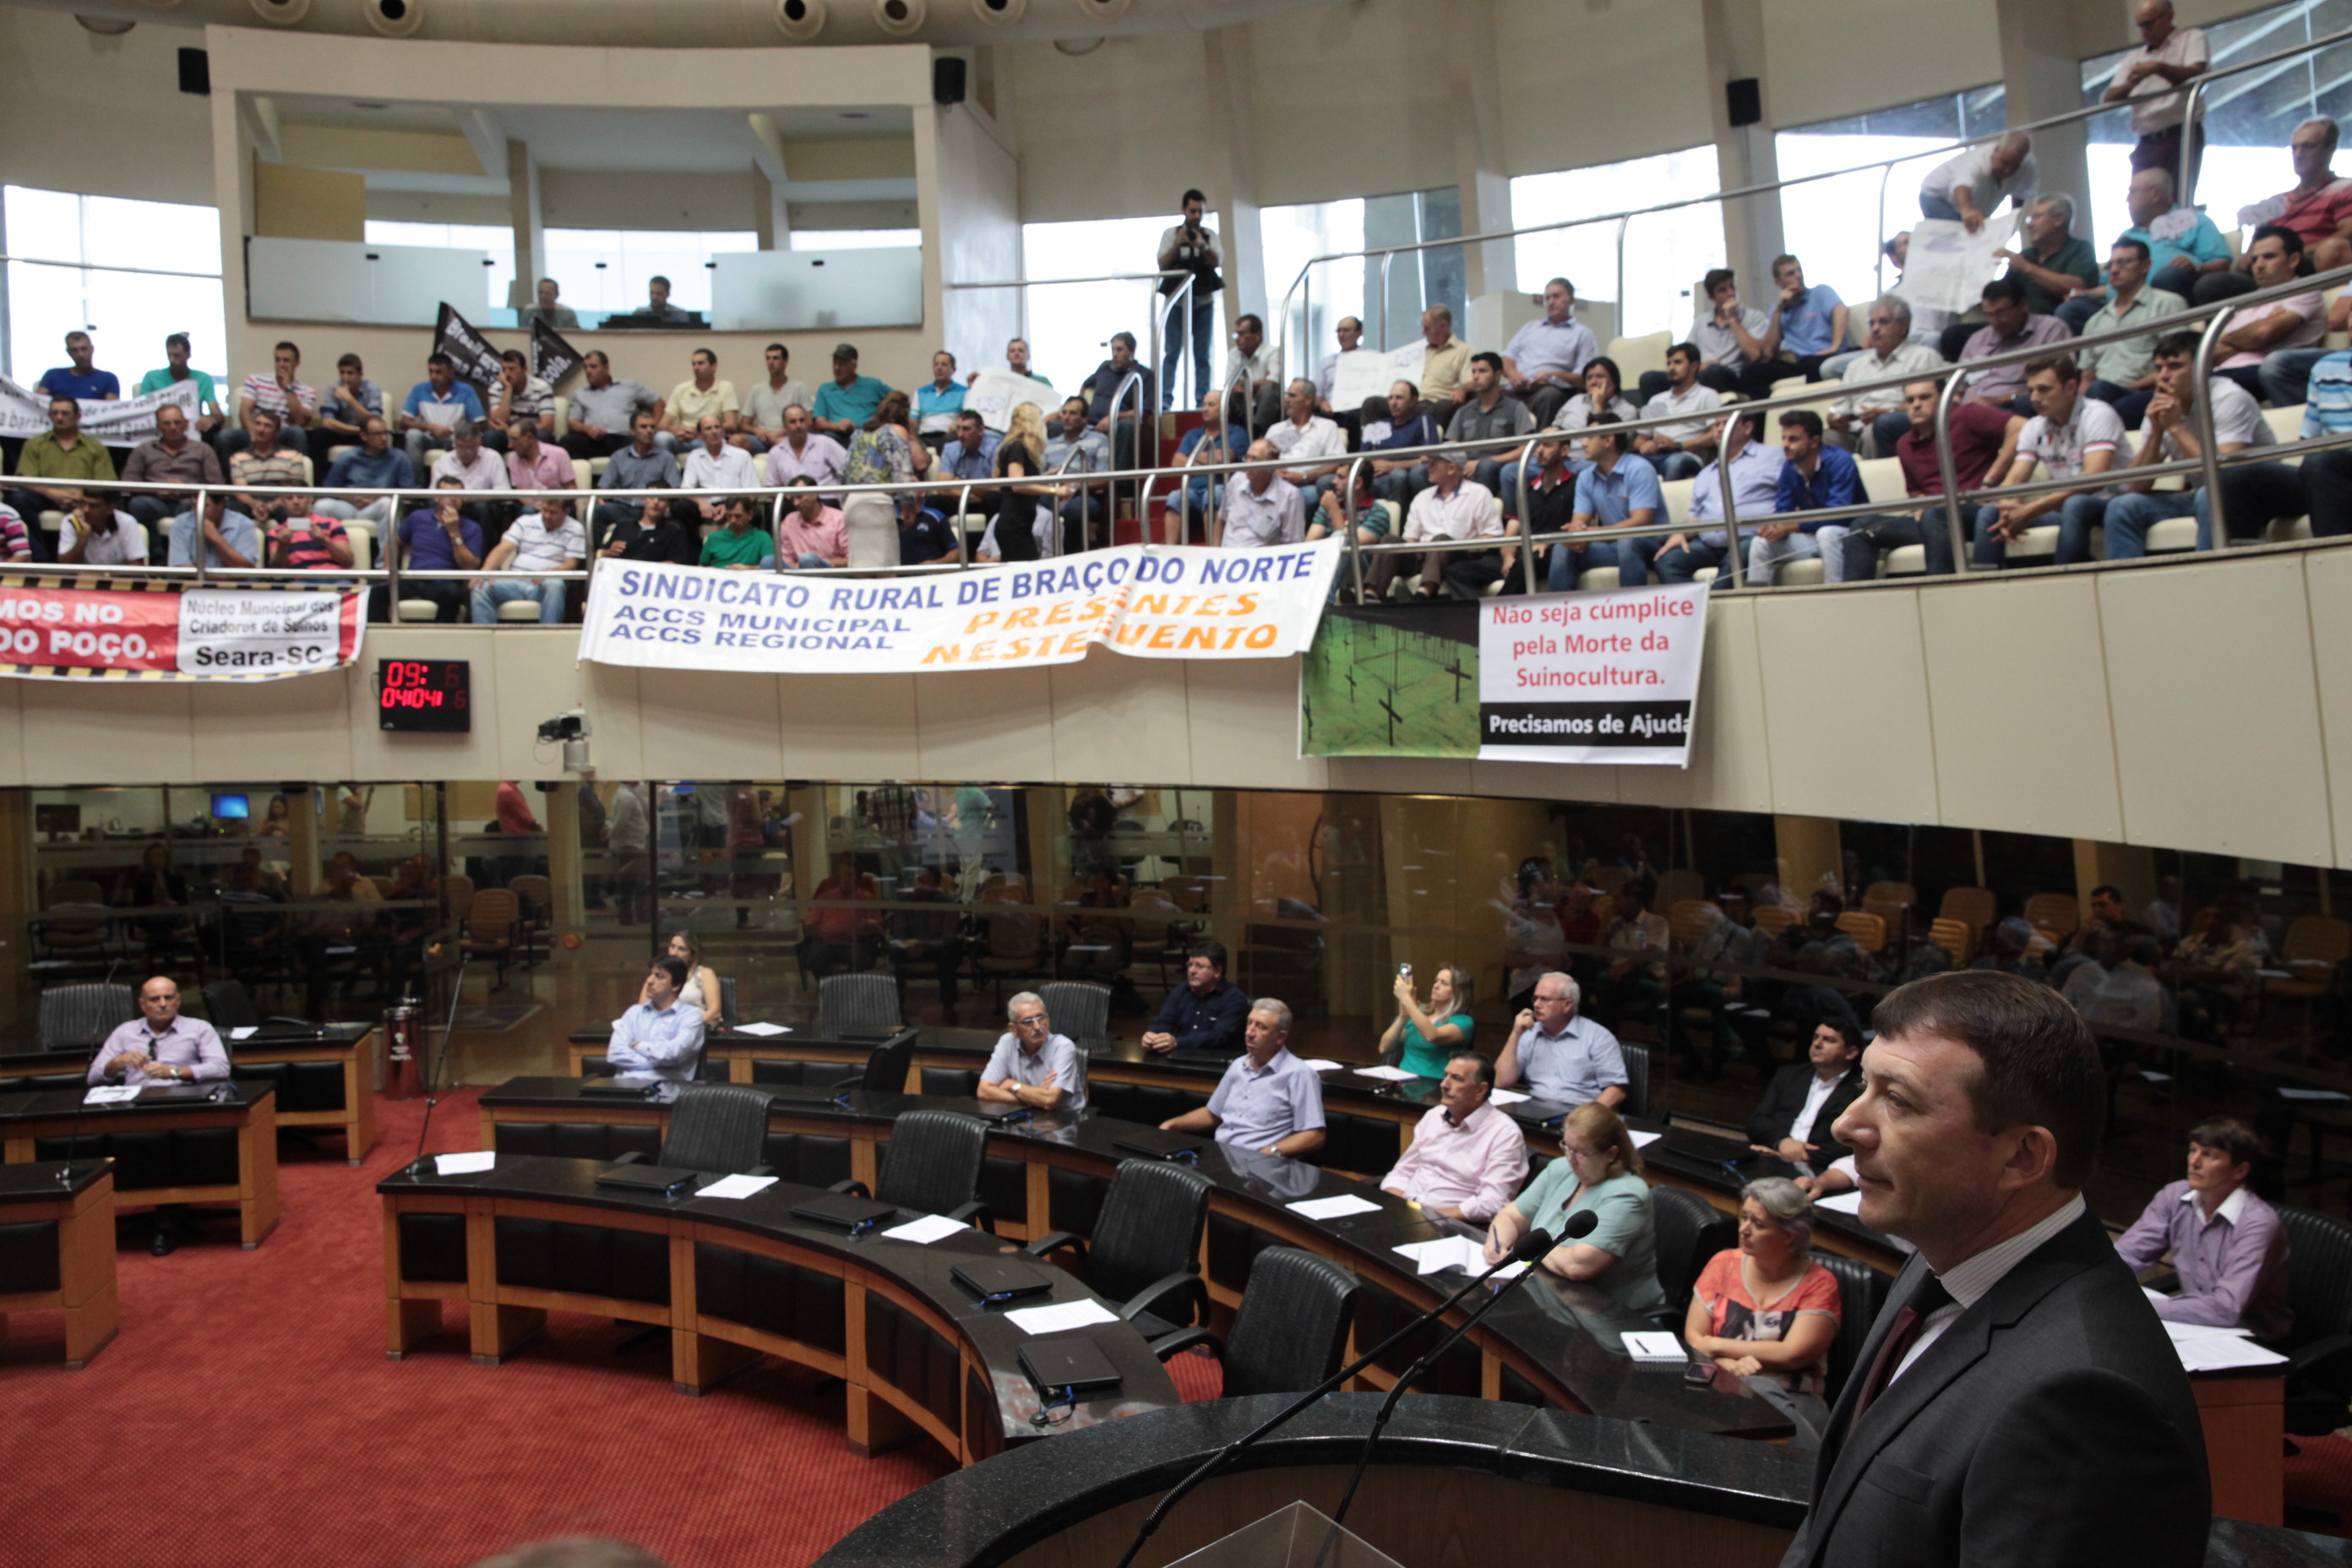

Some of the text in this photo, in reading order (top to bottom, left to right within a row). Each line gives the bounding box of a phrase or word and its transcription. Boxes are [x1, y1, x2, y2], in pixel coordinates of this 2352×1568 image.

[618, 551, 1315, 611] SINDICATO RURAL DE BRAÇO DO NORTE
[74, 602, 123, 624] NO
[187, 599, 334, 616] Núcleo Municipal dos
[613, 605, 911, 633] ACCS MUNICIPAL
[1493, 596, 1695, 627] Não seja cúmplice
[190, 618, 257, 634] Criadores
[263, 619, 279, 633] de
[608, 624, 894, 650] ACCS REGIONAL
[50, 629, 156, 664] POÇO.
[195, 645, 324, 667] Seara-SC
[920, 629, 1089, 664] NESTE
[1512, 630, 1669, 660] pela Morte da
[1516, 666, 1666, 687] Suinocultura.
[1489, 715, 1594, 735] Precisamos
[1597, 714, 1625, 734] de
